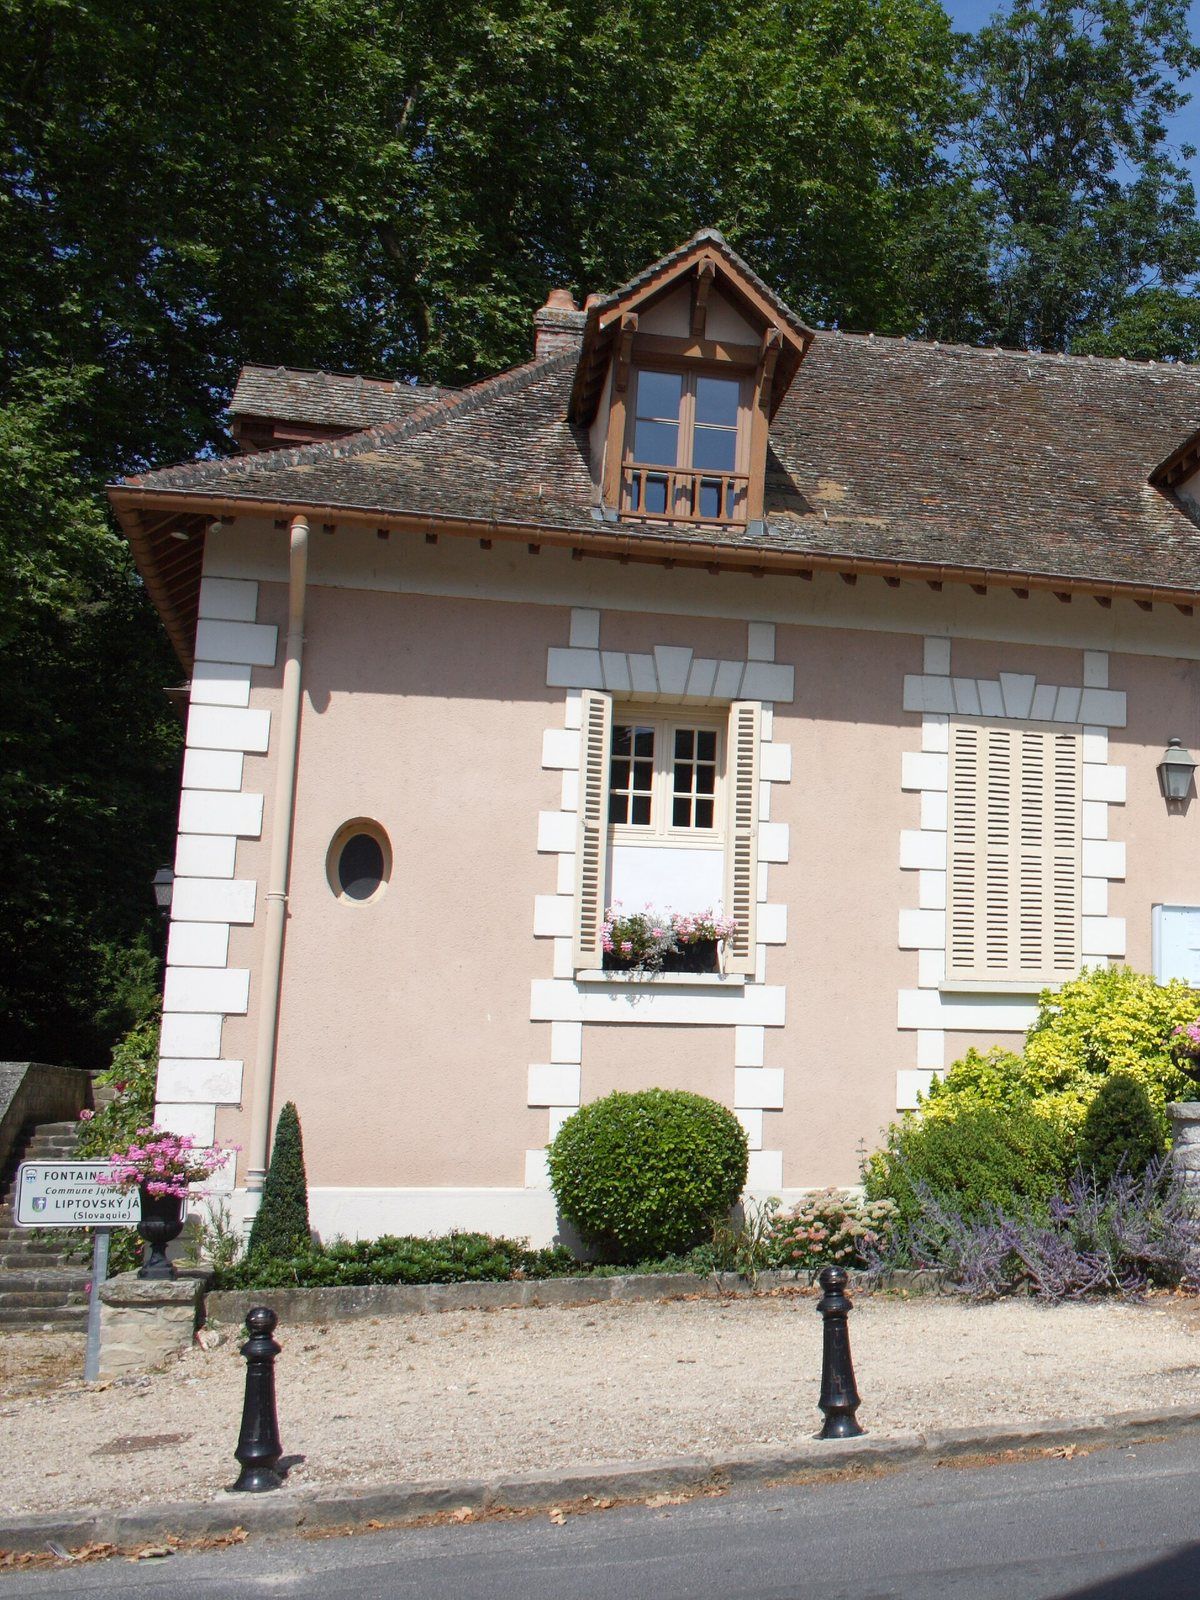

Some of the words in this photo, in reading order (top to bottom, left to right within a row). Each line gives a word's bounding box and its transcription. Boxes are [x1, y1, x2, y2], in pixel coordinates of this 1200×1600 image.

[45, 1187, 94, 1195] Commune
[55, 1197, 124, 1209] LIPTOVSKÝ
[73, 1211, 131, 1221] (Slovaquie)
